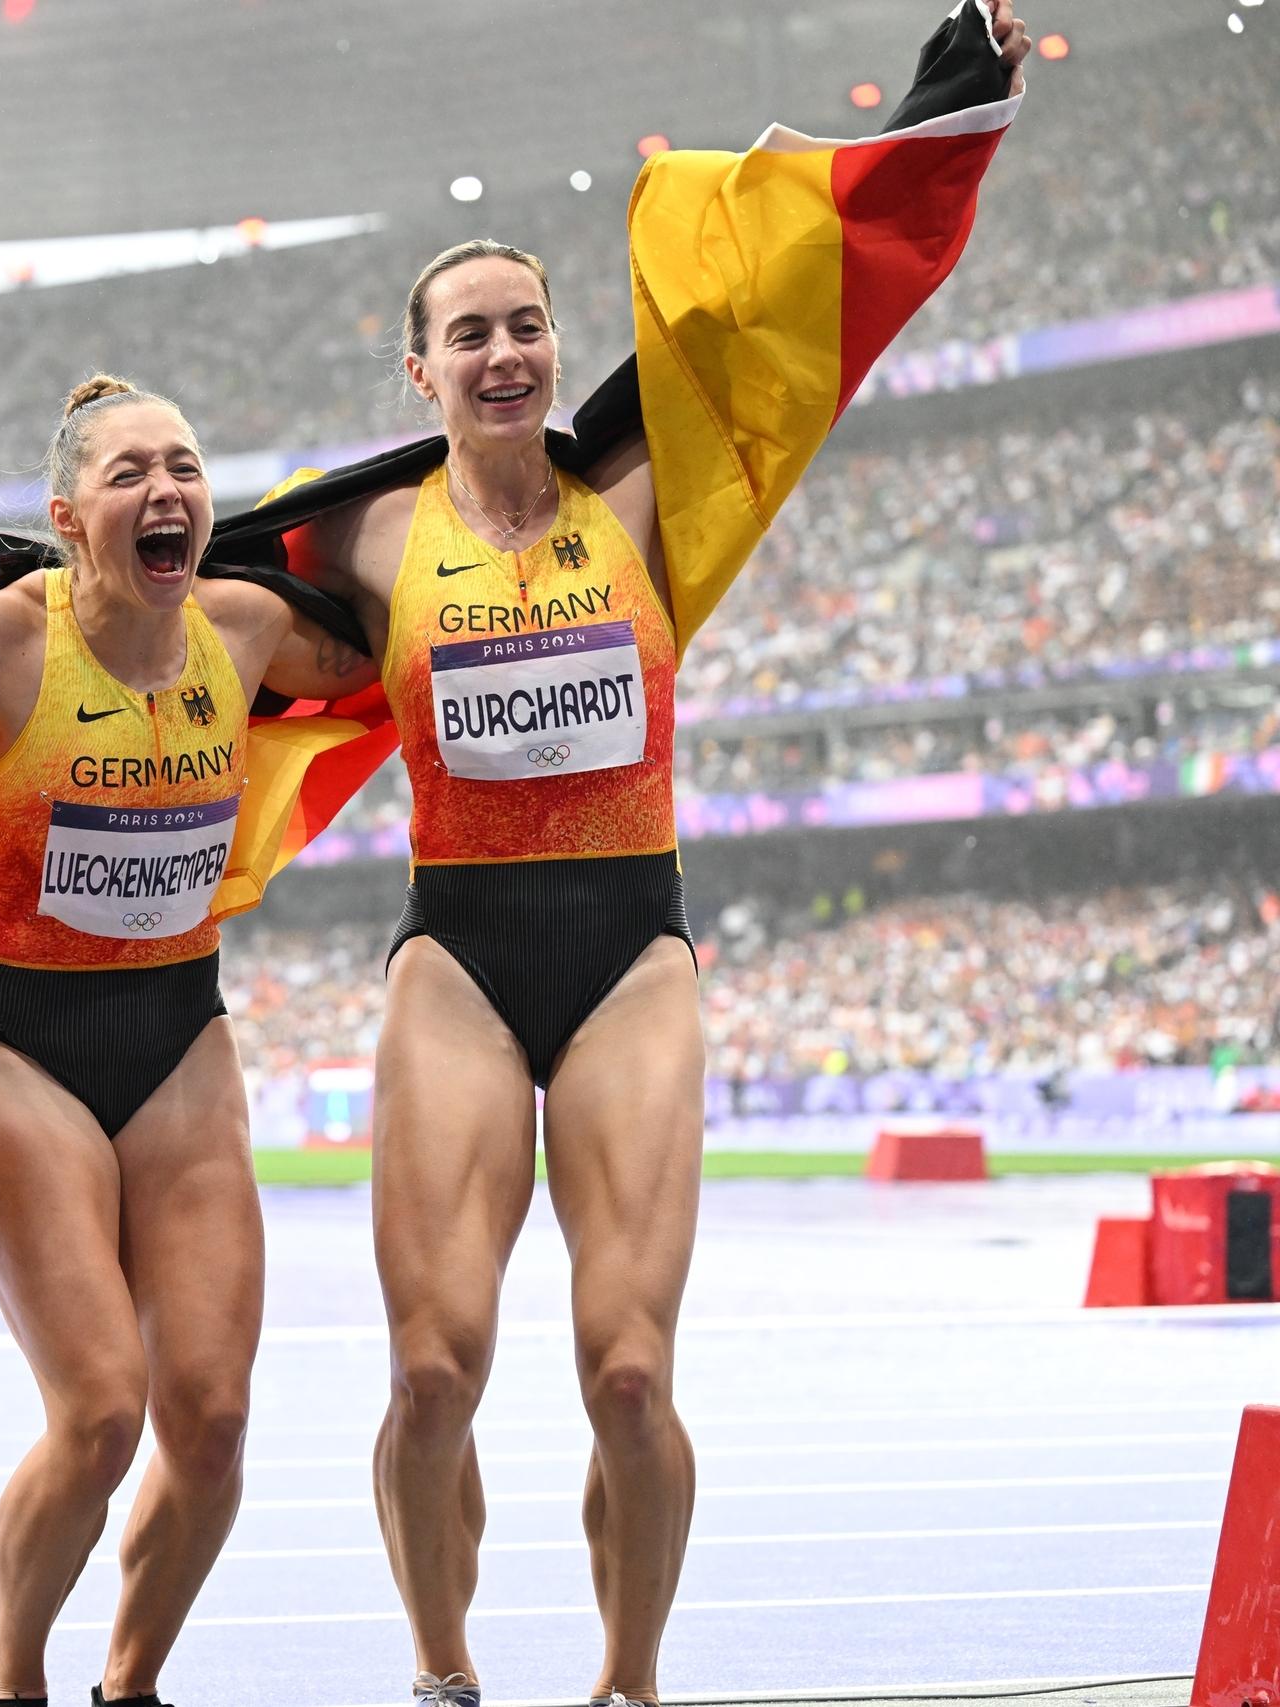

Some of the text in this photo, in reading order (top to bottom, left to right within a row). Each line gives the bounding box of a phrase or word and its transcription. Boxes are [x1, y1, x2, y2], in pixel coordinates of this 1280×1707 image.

[439, 584, 612, 633] GERMANY
[540, 633, 586, 650] 2024
[442, 673, 634, 741] BURGHARDT
[71, 741, 233, 788] GERMANY
[164, 810, 204, 825] 2024
[44, 842, 227, 898] LUECKENKEMPER
